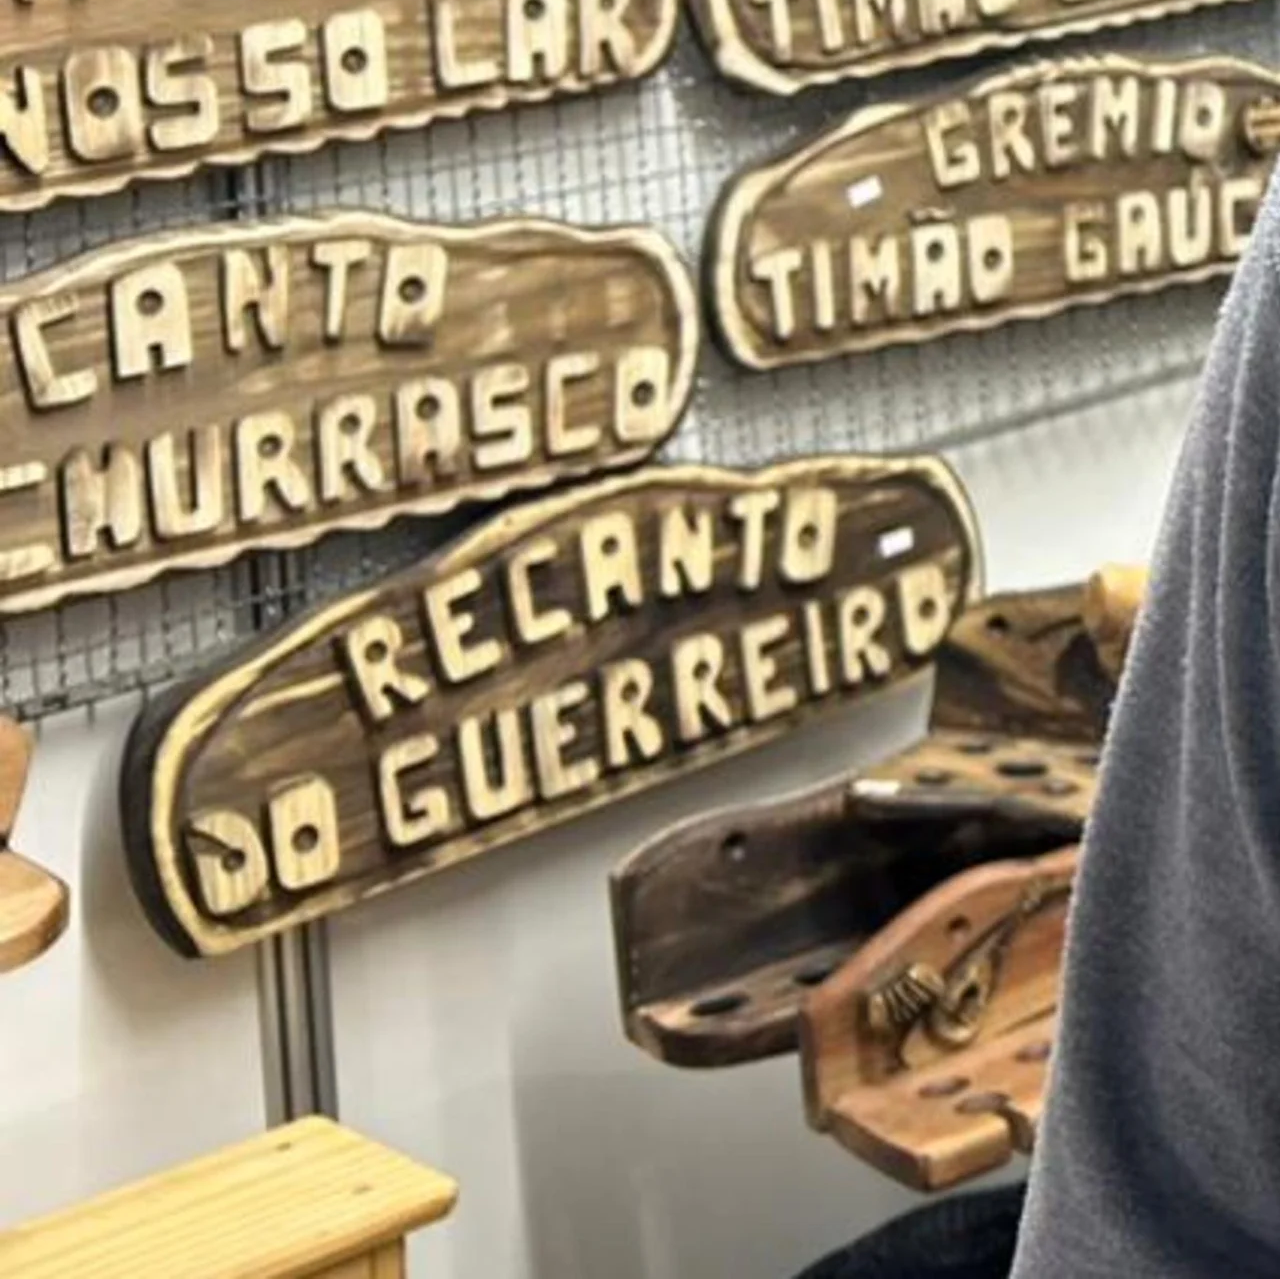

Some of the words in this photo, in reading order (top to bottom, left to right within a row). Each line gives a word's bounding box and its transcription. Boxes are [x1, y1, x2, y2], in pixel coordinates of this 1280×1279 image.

[17, 239, 449, 410] CANTO
[751, 208, 1014, 341] TIMÃO
[344, 486, 837, 720] RECANTO
[190, 771, 339, 915] DO
[379, 563, 950, 846] GUERREIRO
